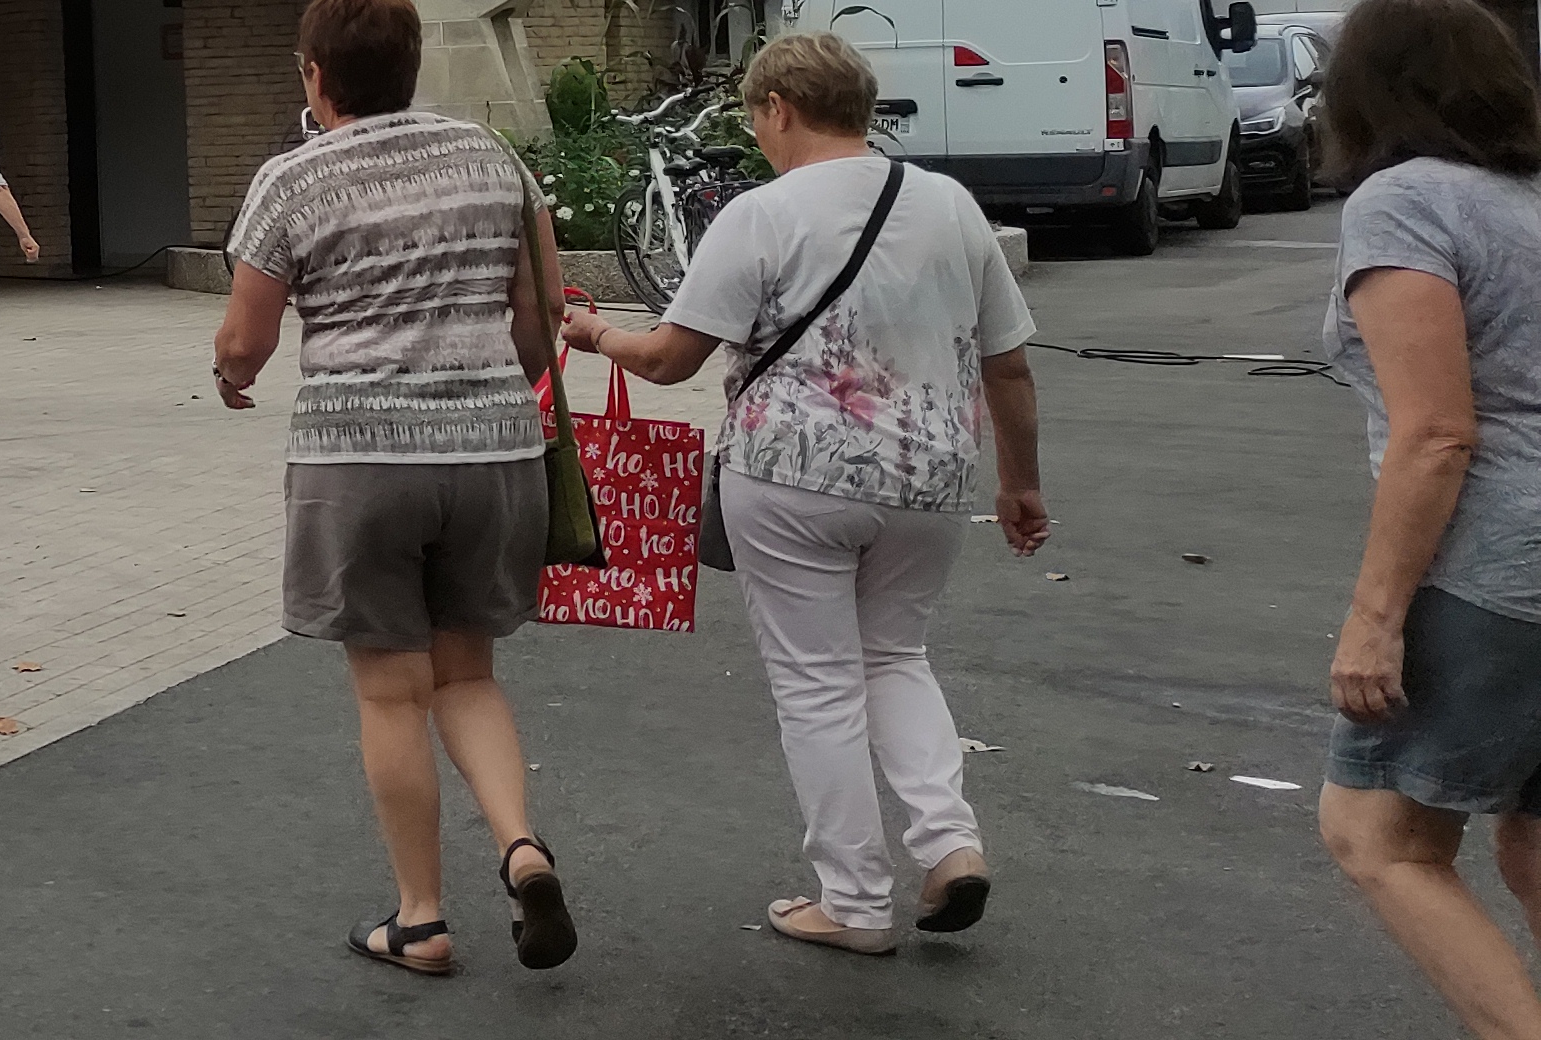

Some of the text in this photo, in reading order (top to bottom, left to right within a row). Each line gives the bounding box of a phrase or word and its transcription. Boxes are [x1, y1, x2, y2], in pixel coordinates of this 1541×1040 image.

[607, 432, 643, 477] ho
[621, 492, 659, 520] HO
[639, 524, 675, 558] ho
[573, 590, 611, 622] ho
